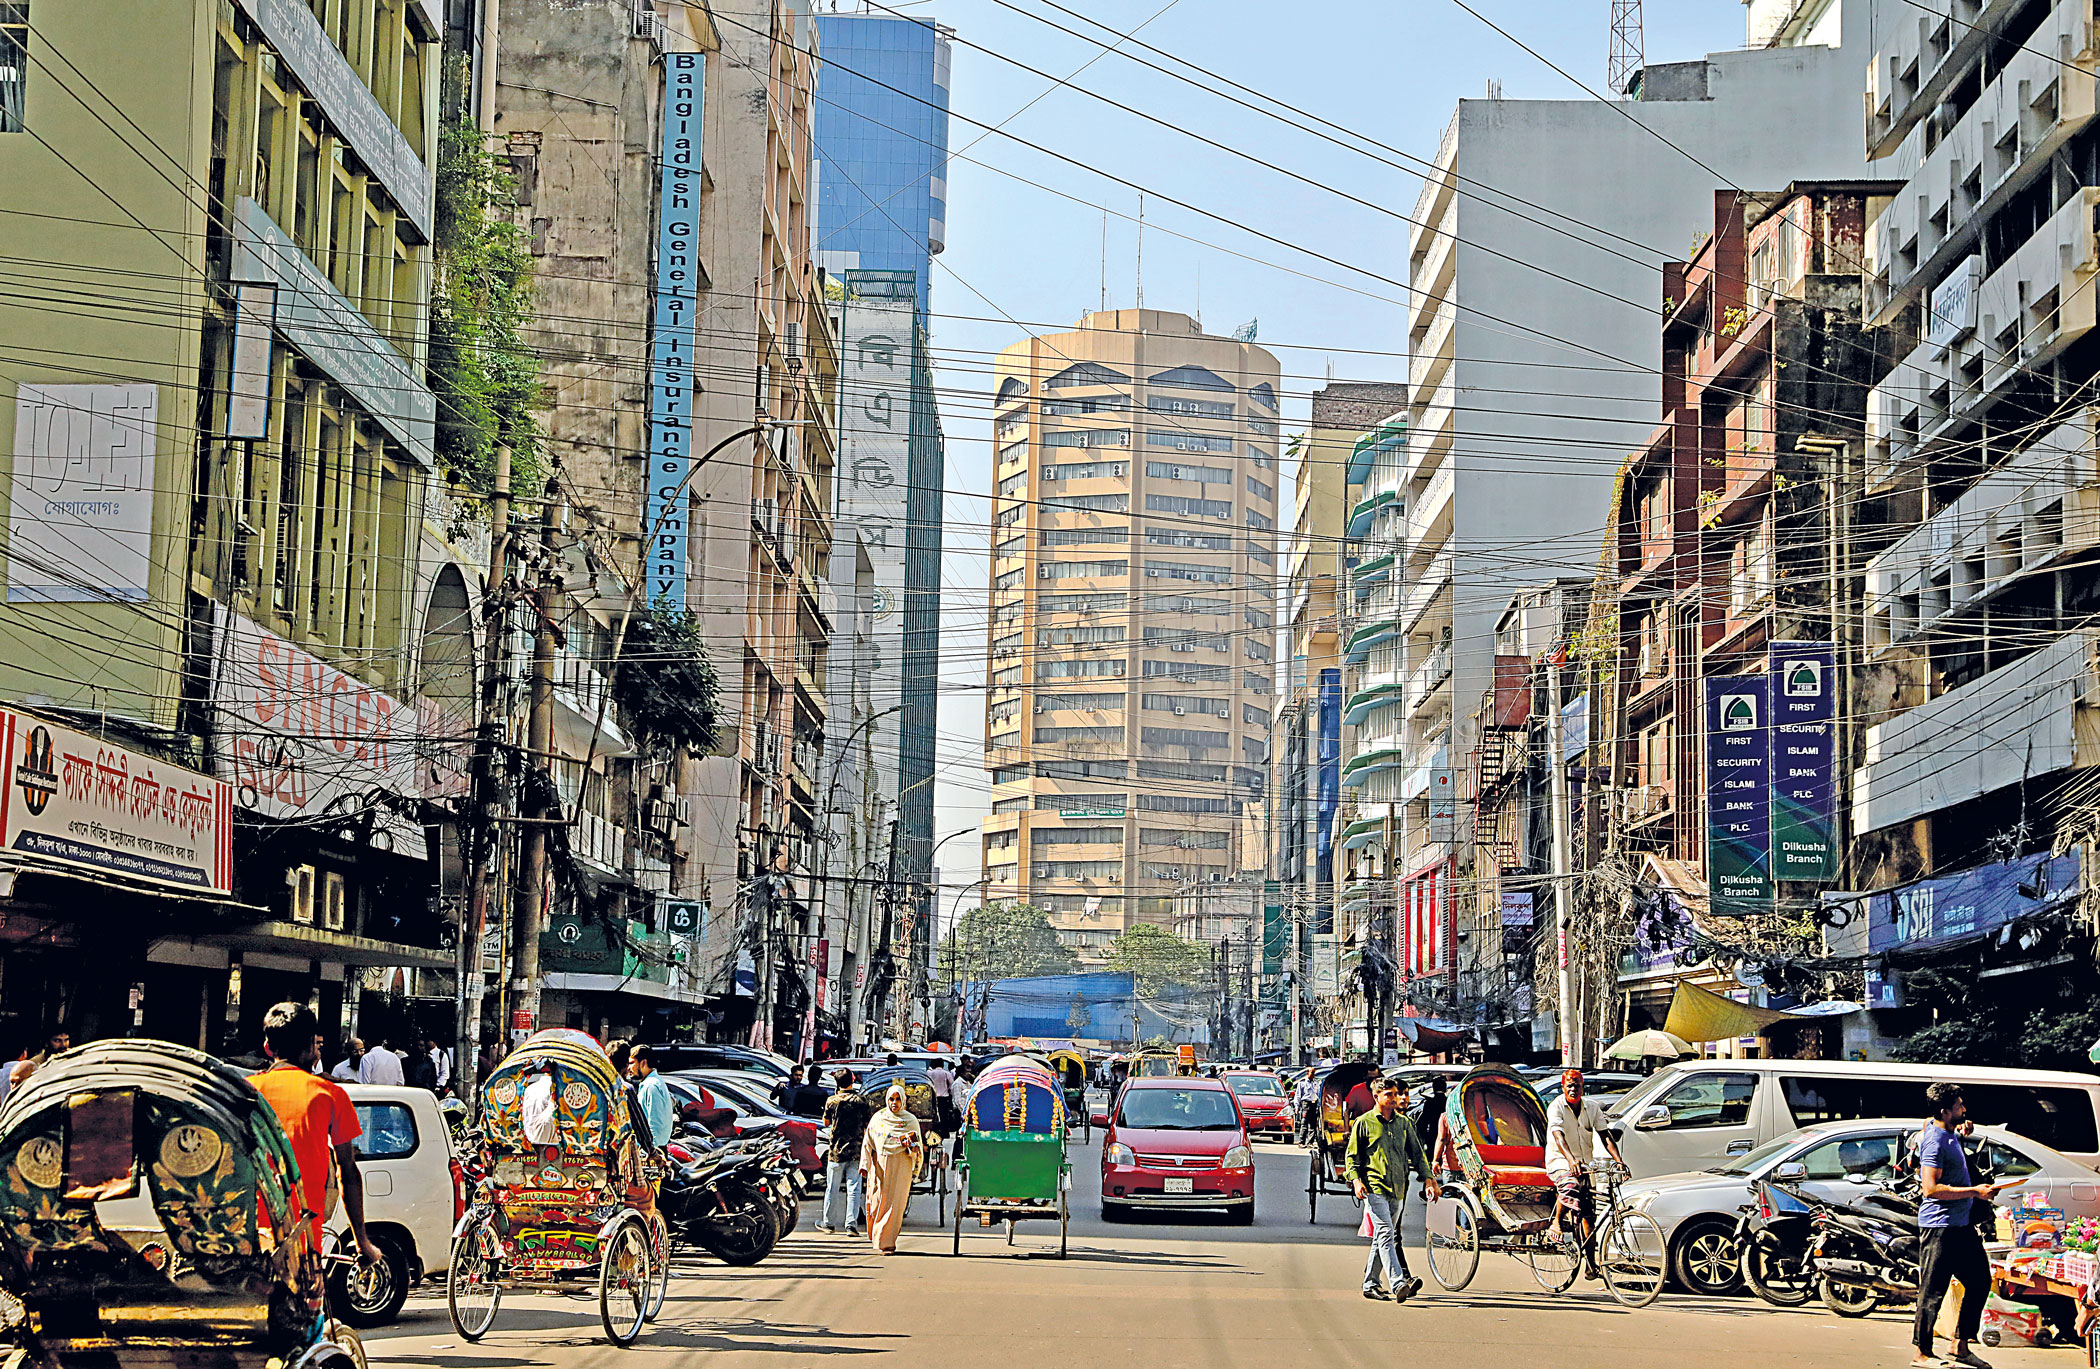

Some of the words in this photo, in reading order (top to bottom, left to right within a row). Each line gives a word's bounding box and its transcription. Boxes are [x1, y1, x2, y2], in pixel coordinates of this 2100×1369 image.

[269, 8, 300, 58] ISLAMI
[301, 50, 348, 117] INSURANCE
[350, 113, 400, 186] BANGLADESH
[401, 177, 426, 217] LIMITED
[672, 55, 696, 209] Bangladesh
[668, 222, 691, 326] General
[661, 338, 682, 474] Insurance
[44, 501, 120, 516] যোগাযোগঃ
[655, 486, 681, 594] Company
[254, 633, 393, 773] SINGER
[1789, 703, 1816, 711] FIRST
[1726, 737, 1752, 745] FIRST
[1787, 747, 1819, 755] ISLAMI
[1717, 758, 1762, 767] SECURITY
[1789, 768, 1817, 777] BANK
[1724, 780, 1755, 788] ISLAMI
[130, 764, 160, 824] হোটেল
[1726, 802, 1754, 810] BANK
[68, 820, 89, 837] এখানে
[1782, 842, 1826, 851] Dilkusha
[1786, 854, 1823, 863] Branch
[1720, 875, 1763, 884] Dilkusha
[1724, 887, 1759, 896] Branch
[1910, 887, 1934, 940] SBI
[514, 1227, 598, 1252] নিরব
